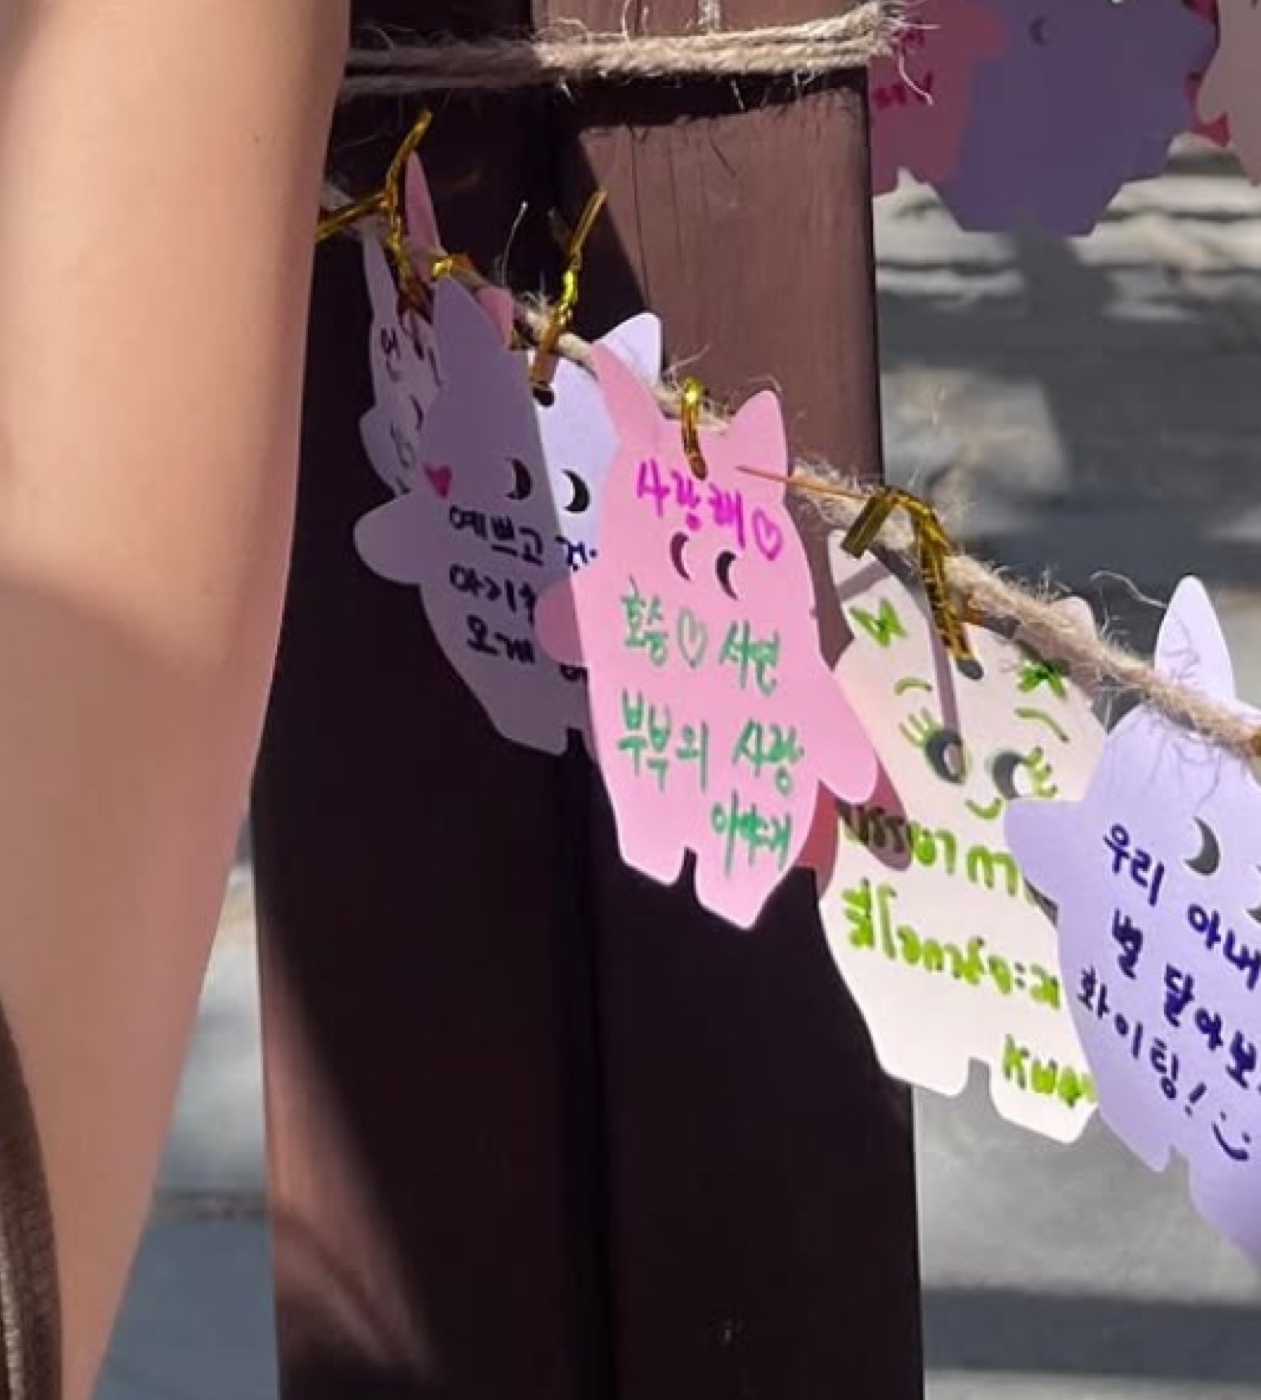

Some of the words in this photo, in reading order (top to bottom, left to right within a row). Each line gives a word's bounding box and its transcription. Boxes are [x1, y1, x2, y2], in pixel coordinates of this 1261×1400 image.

[448, 503, 545, 568] 예쁘고
[636, 456, 746, 550] 사랑해
[617, 686, 710, 792] 부부의
[731, 718, 805, 796] 사랑
[1102, 821, 1166, 906] 우리
[1077, 964, 1208, 1117] 화이팅!
